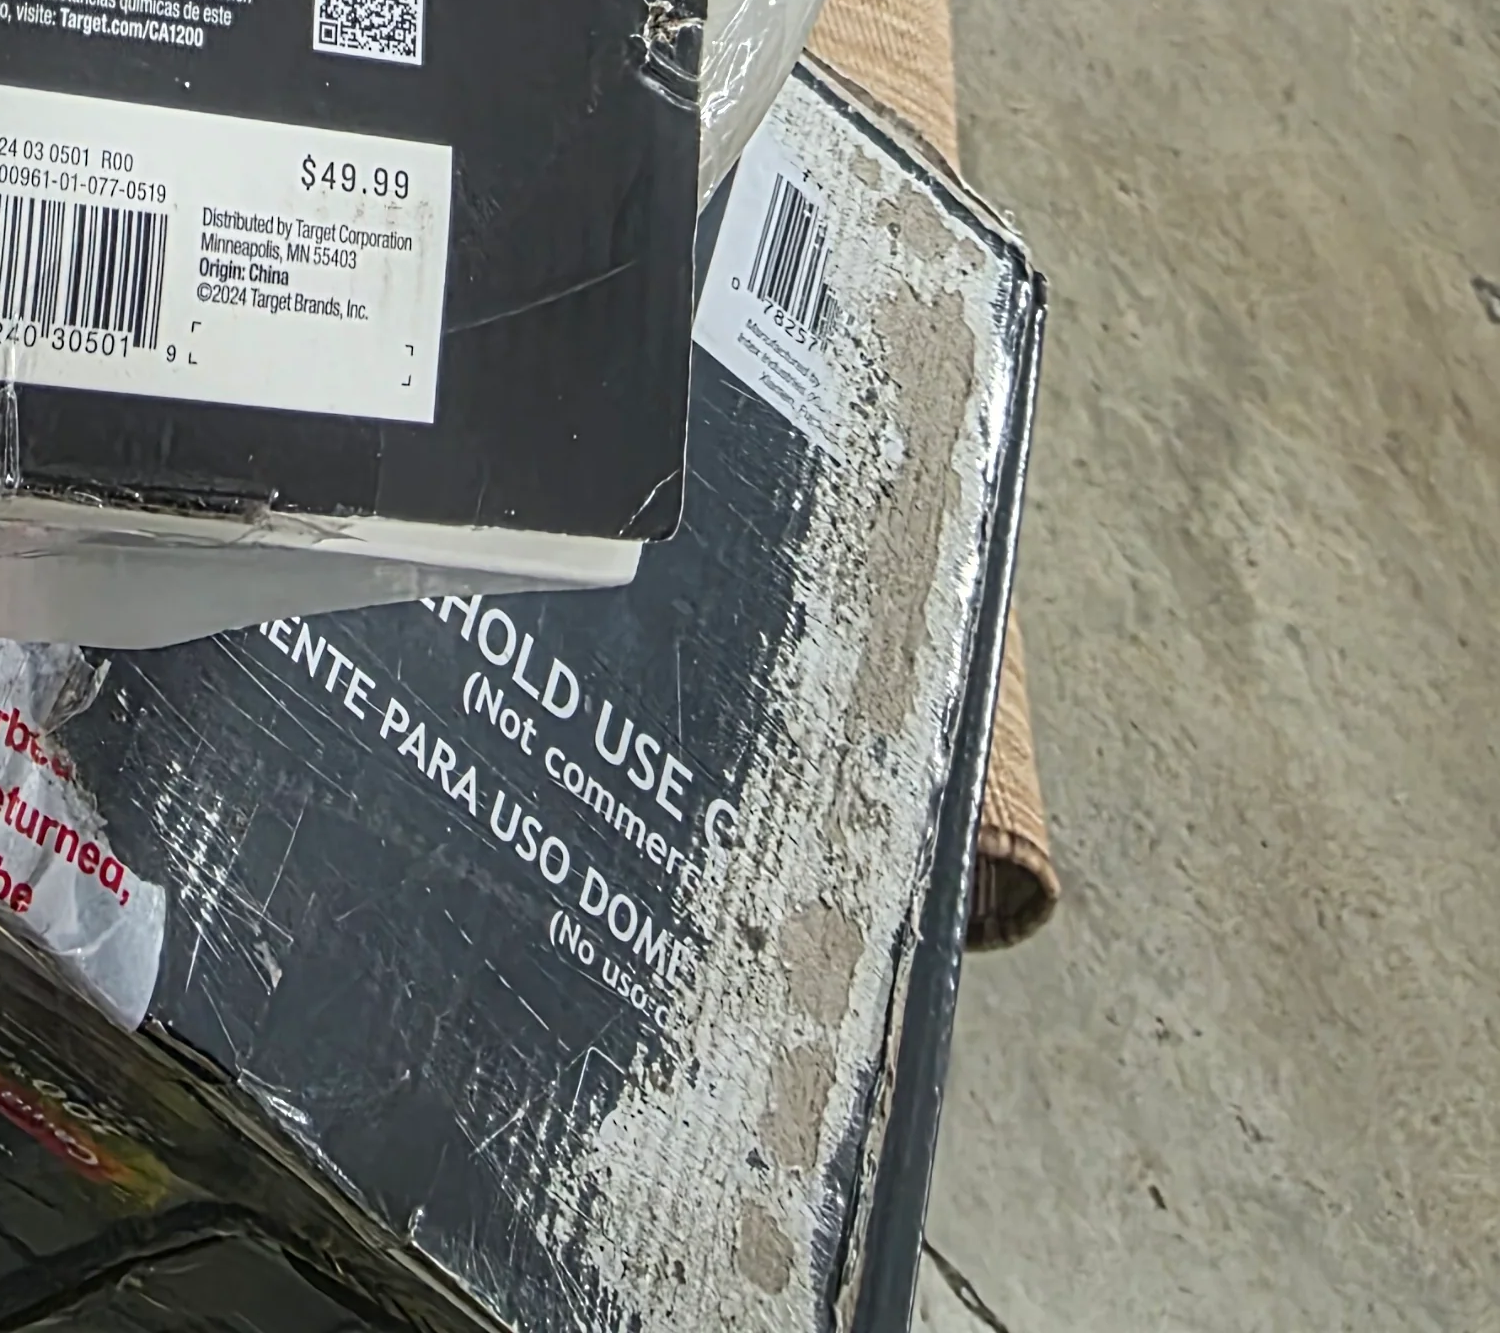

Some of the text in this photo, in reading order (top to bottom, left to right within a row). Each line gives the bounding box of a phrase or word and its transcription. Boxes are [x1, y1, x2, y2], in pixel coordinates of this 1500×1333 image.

[16, 2, 56, 25] visite:
[60, 7, 204, 47] Target.com/CA1200
[23, 140, 44, 161] 03
[49, 144, 88, 167] 0501
[101, 150, 133, 172] R00
[301, 154, 409, 199] $49.99
[201, 232, 357, 269] Minneapolis, MN 55403
[203, 207, 412, 251] Distributed by Target Corporation
[199, 257, 289, 286] Origin: China
[197, 282, 368, 320] ©2024 Target Brands, Inc.
[51, 327, 129, 358] 30501
[165, 344, 177, 363] 9
[762, 298, 819, 352] 78257
[463, 672, 536, 755] (Not
[594, 701, 692, 820] USE
[380, 698, 572, 885] PARA USO
[549, 909, 595, 965] (No
